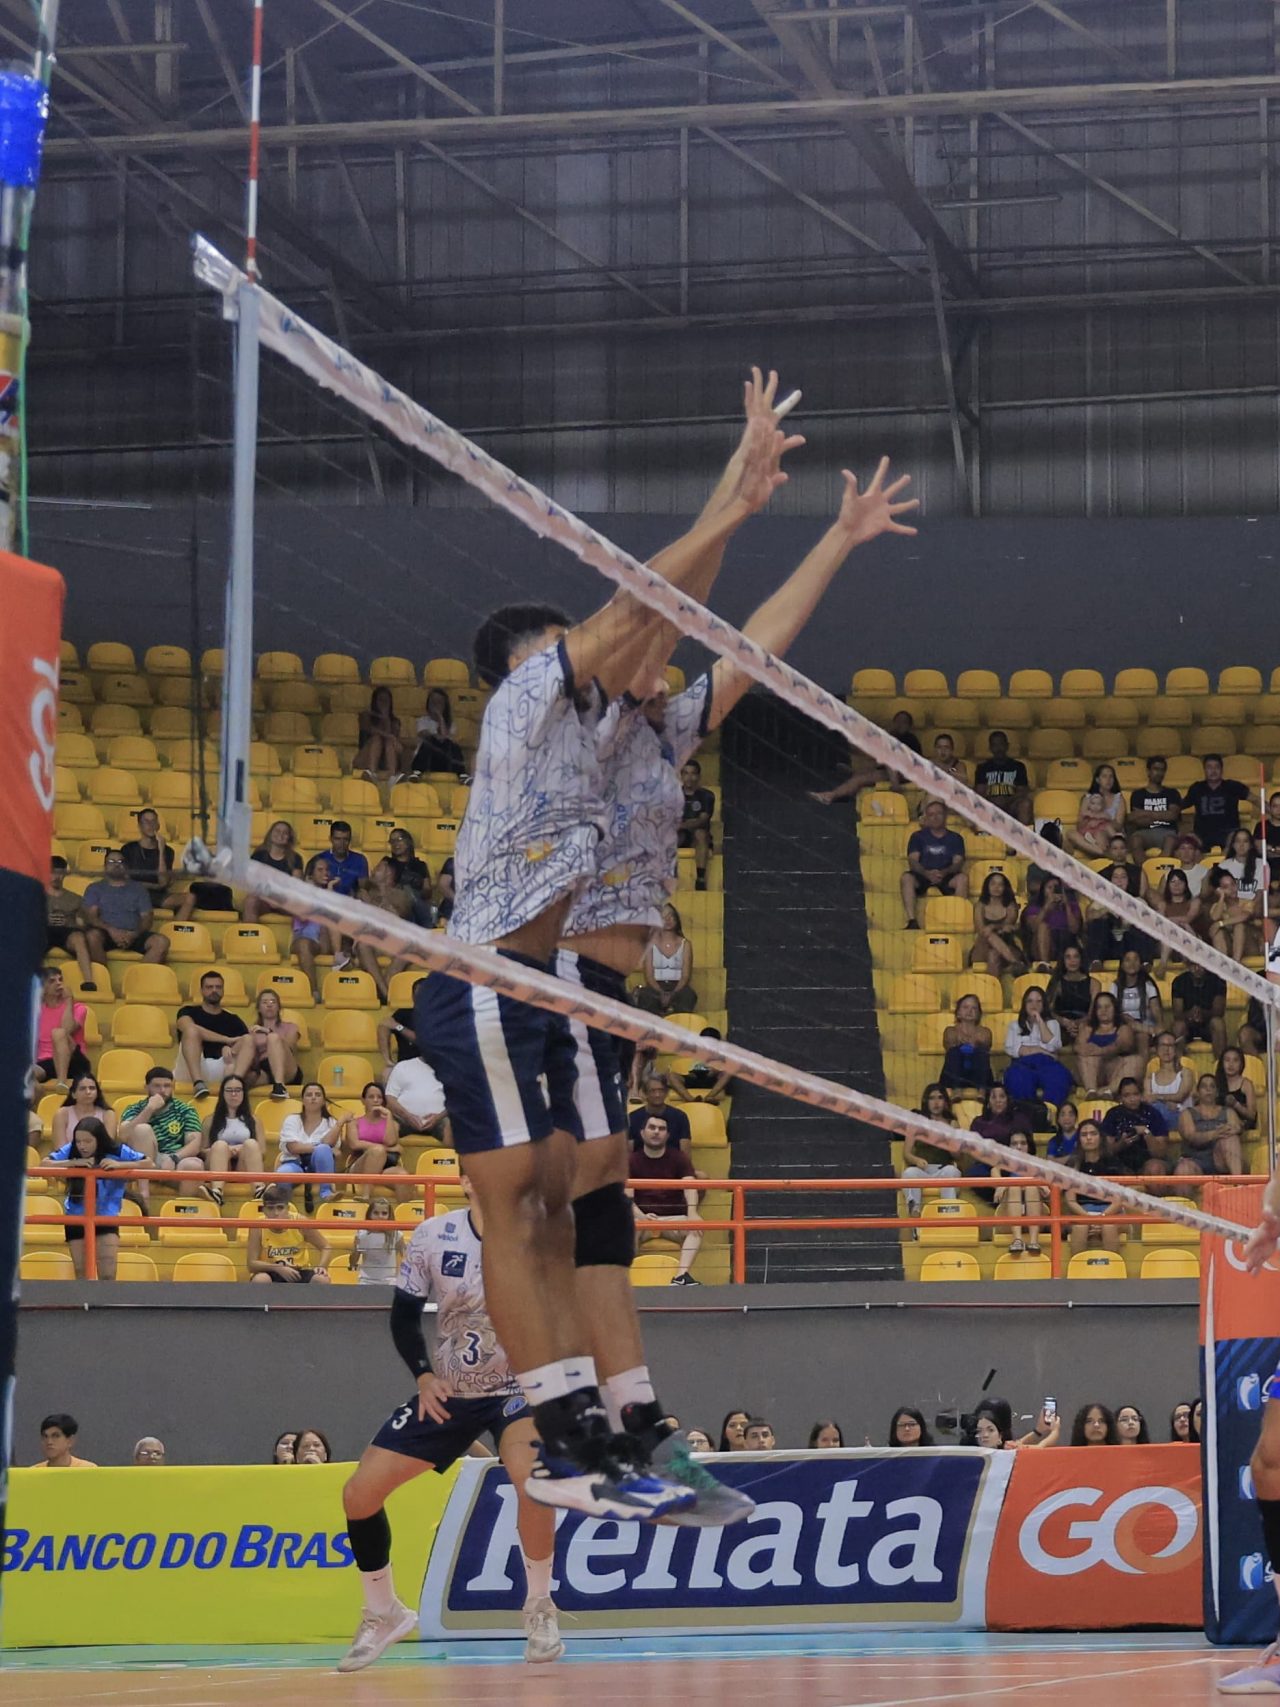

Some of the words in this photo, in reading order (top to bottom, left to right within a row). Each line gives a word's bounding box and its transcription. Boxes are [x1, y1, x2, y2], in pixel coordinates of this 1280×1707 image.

[462, 1331, 482, 1366] 3
[391, 1404, 413, 1429] 3
[1, 1528, 156, 1571] BANCO
[161, 1532, 228, 1569] DO
[231, 1525, 355, 1569] BRAS
[1018, 1486, 1203, 1576] GO
